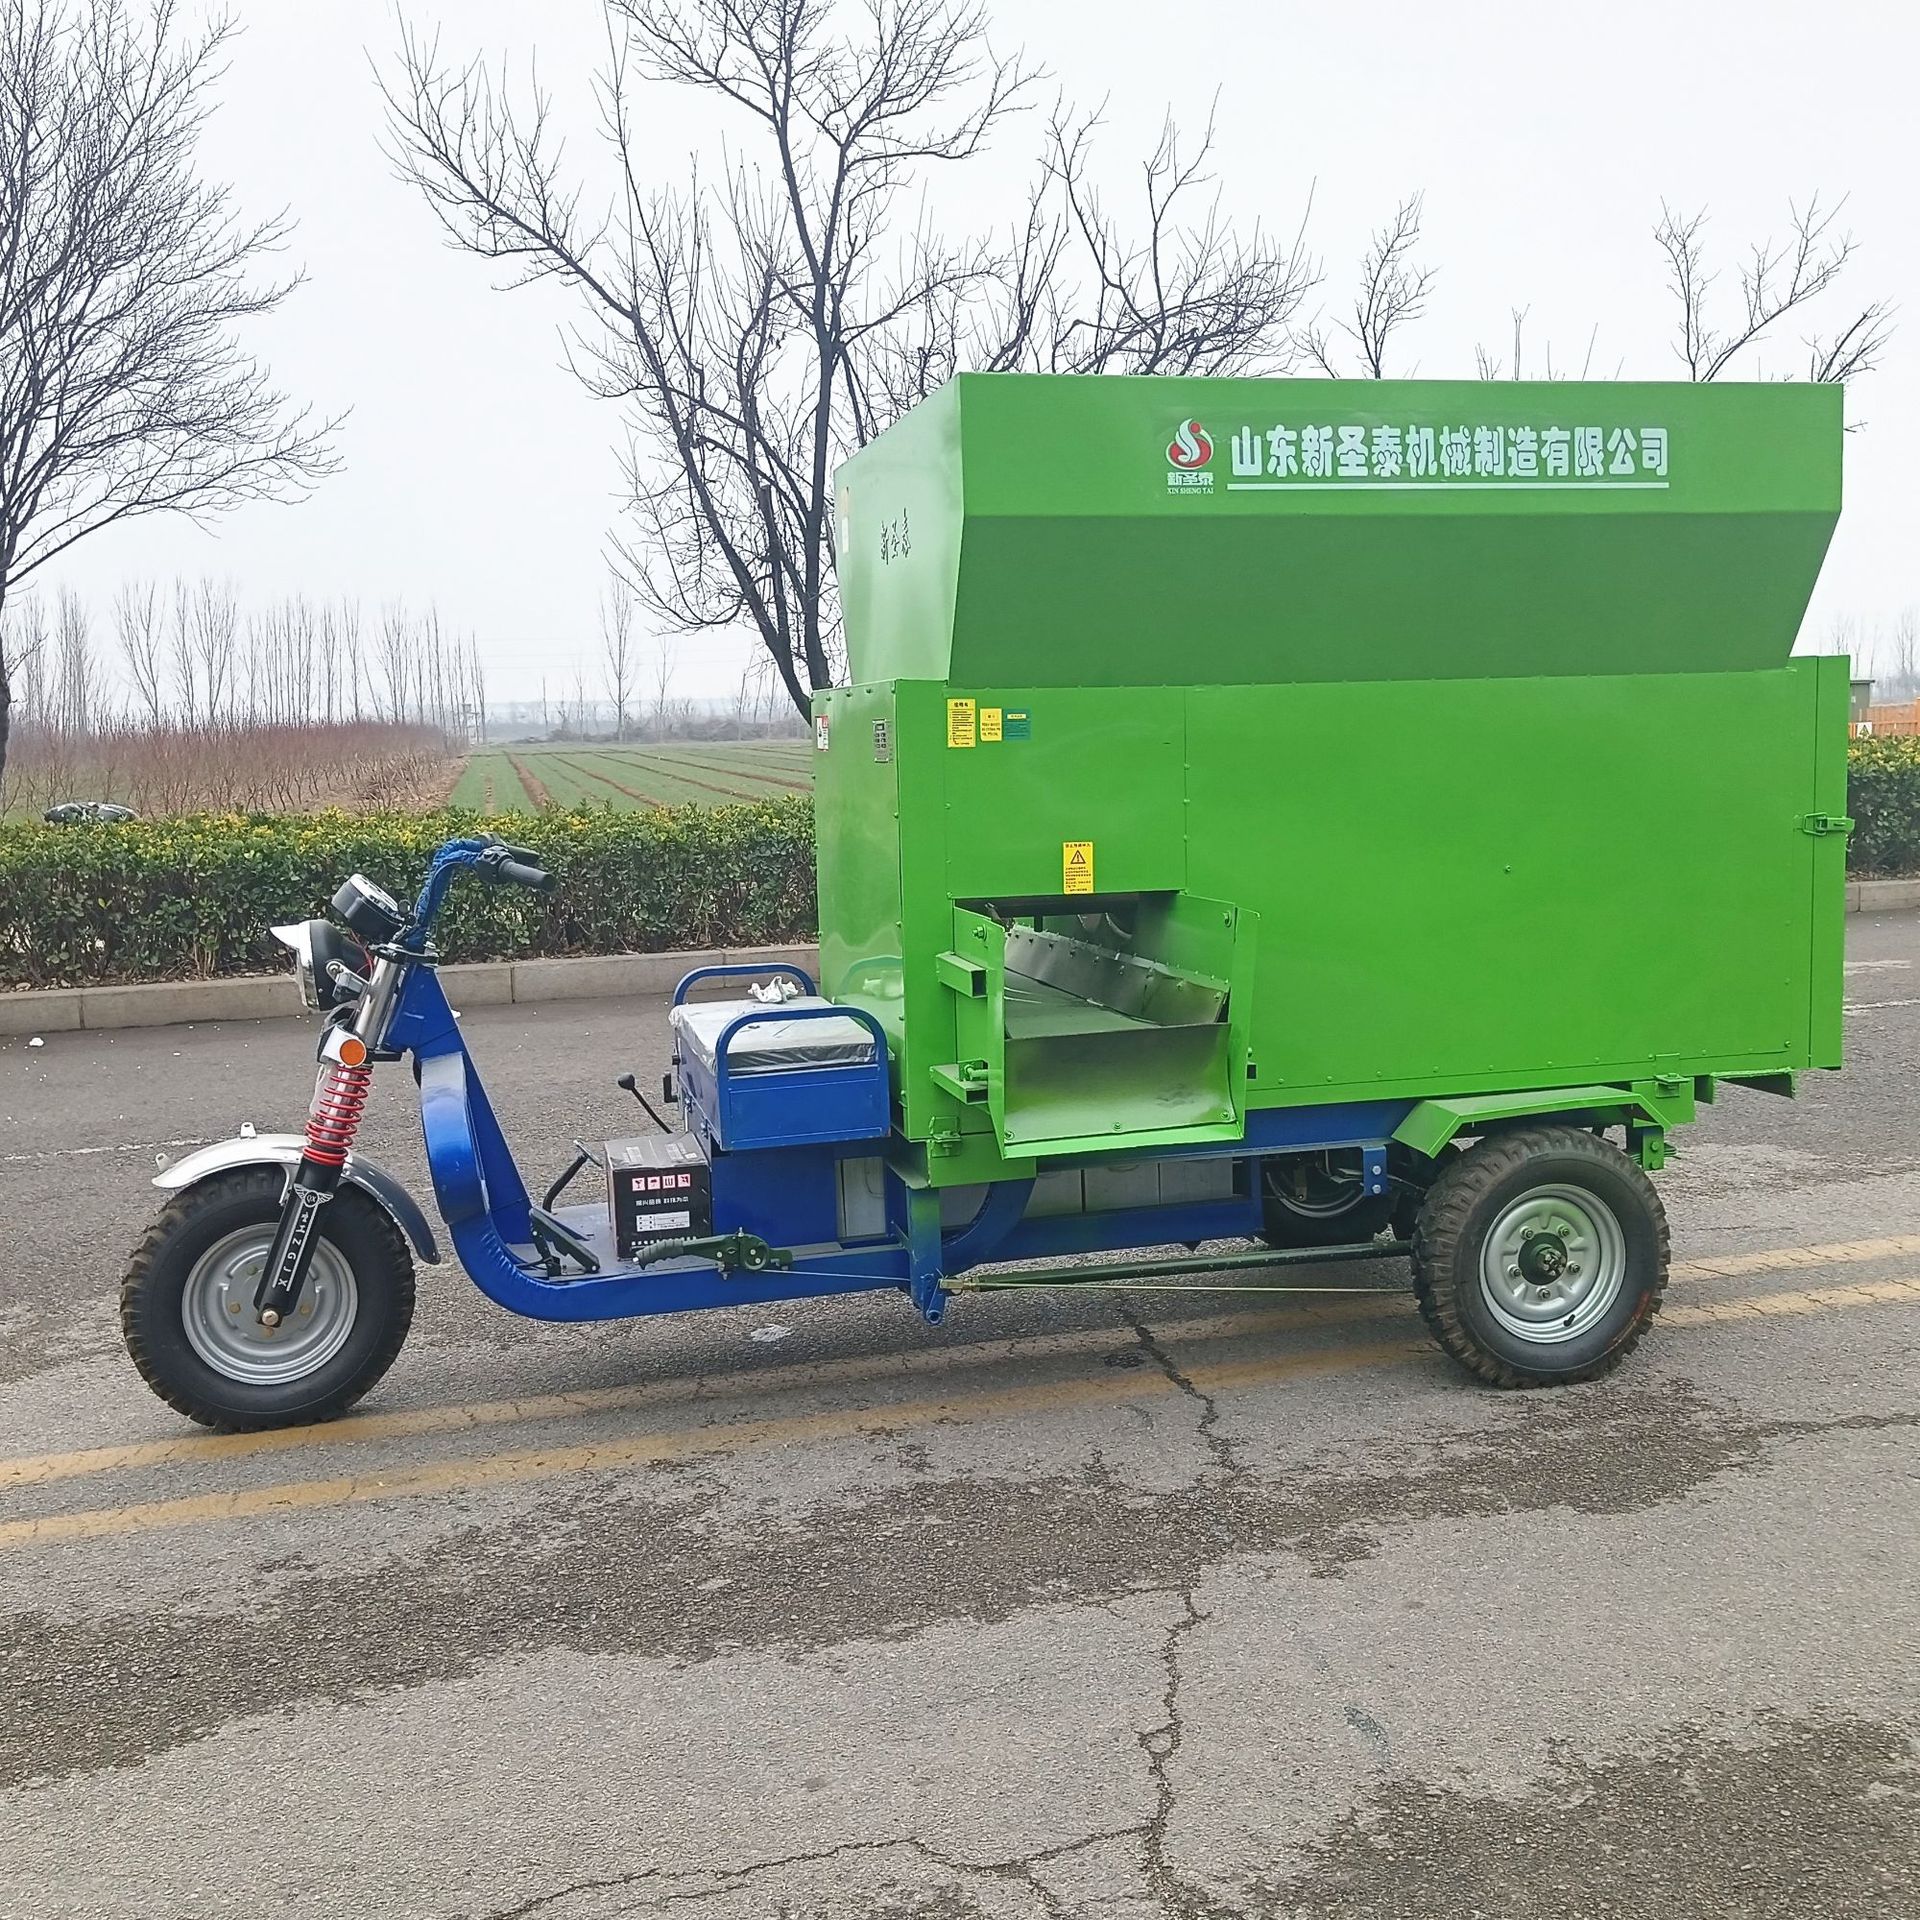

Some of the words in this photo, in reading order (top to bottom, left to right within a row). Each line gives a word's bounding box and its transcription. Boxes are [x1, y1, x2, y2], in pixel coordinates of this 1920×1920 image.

[1231, 424, 1668, 478] 山东新圣泰机械制造有限公司
[1167, 471, 1214, 486] 新圣泰
[1167, 487, 1179, 495] XIN
[1180, 487, 1202, 495] SHENG
[1203, 487, 1214, 495] TAI
